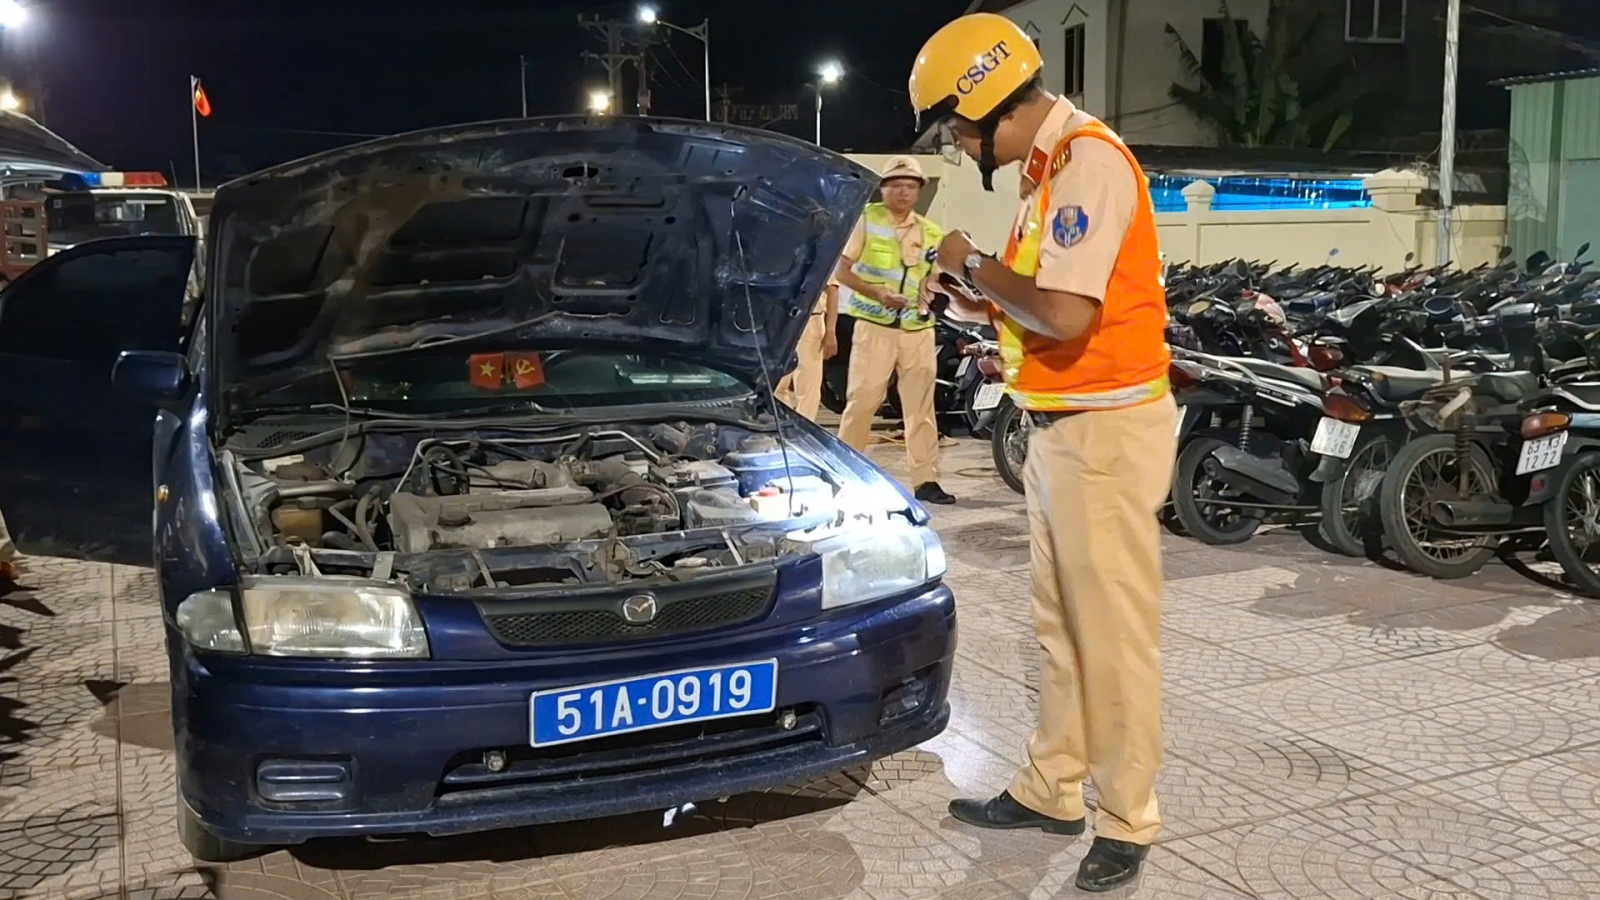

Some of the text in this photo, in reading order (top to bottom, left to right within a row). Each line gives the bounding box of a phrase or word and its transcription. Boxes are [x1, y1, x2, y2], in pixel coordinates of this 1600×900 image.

[956, 40, 1011, 94] CSGT
[1525, 450, 1557, 471] 1272
[557, 669, 752, 736] 51A-0919
